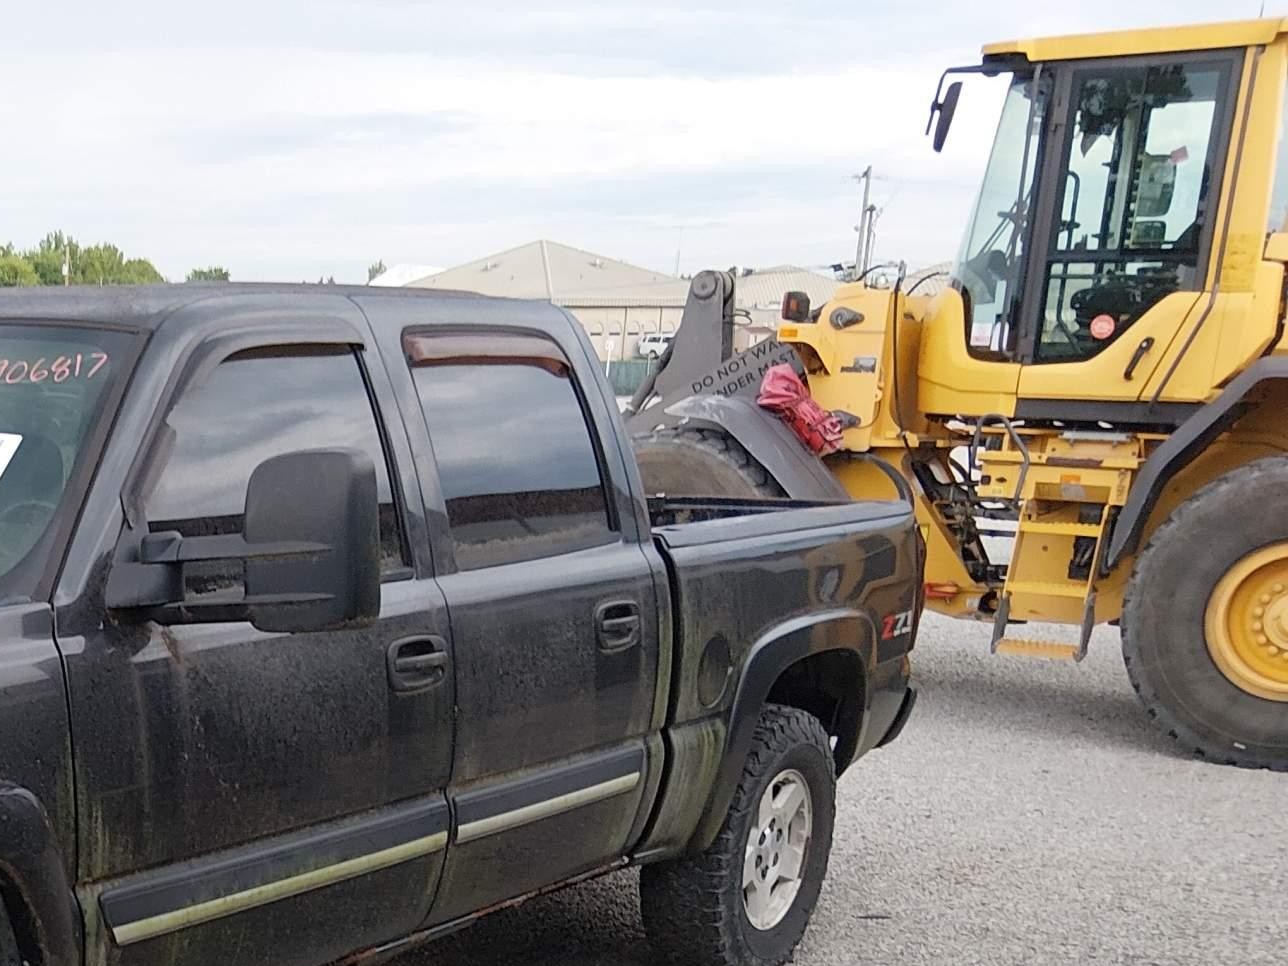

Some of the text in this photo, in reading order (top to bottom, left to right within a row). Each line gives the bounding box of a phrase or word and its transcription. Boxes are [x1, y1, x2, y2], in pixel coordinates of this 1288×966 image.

[692, 375, 714, 394] DO
[717, 356, 748, 380] NOT
[713, 372, 756, 397] NDER
